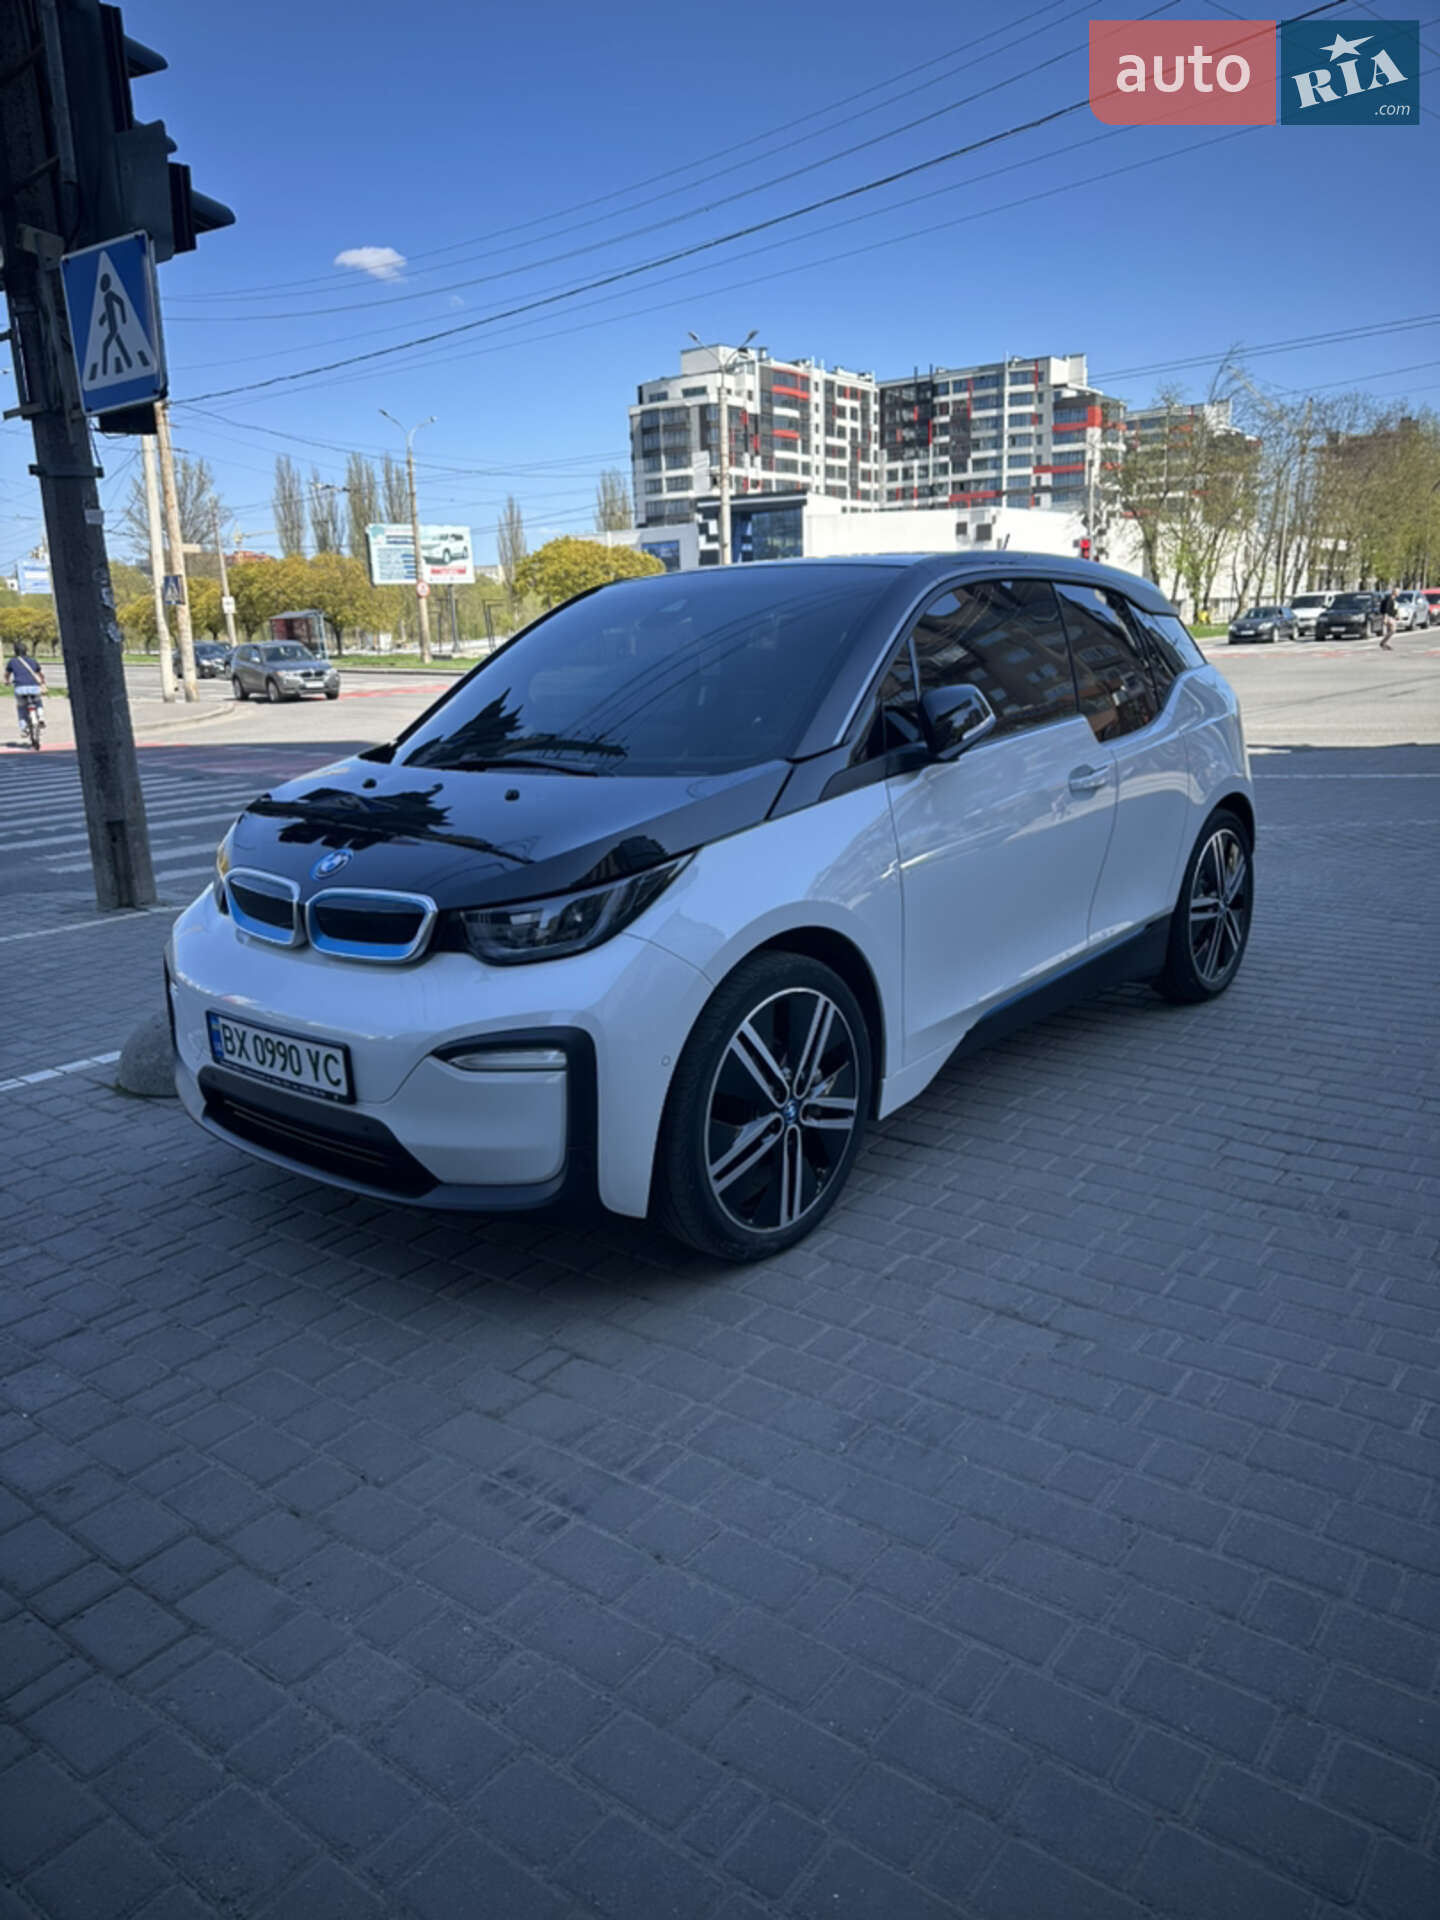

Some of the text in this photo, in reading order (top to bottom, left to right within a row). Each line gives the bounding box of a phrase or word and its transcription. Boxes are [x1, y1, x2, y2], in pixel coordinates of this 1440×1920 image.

[222, 1024, 251, 1062] BX
[253, 1035, 302, 1076] 0990
[306, 1048, 342, 1087] YC
